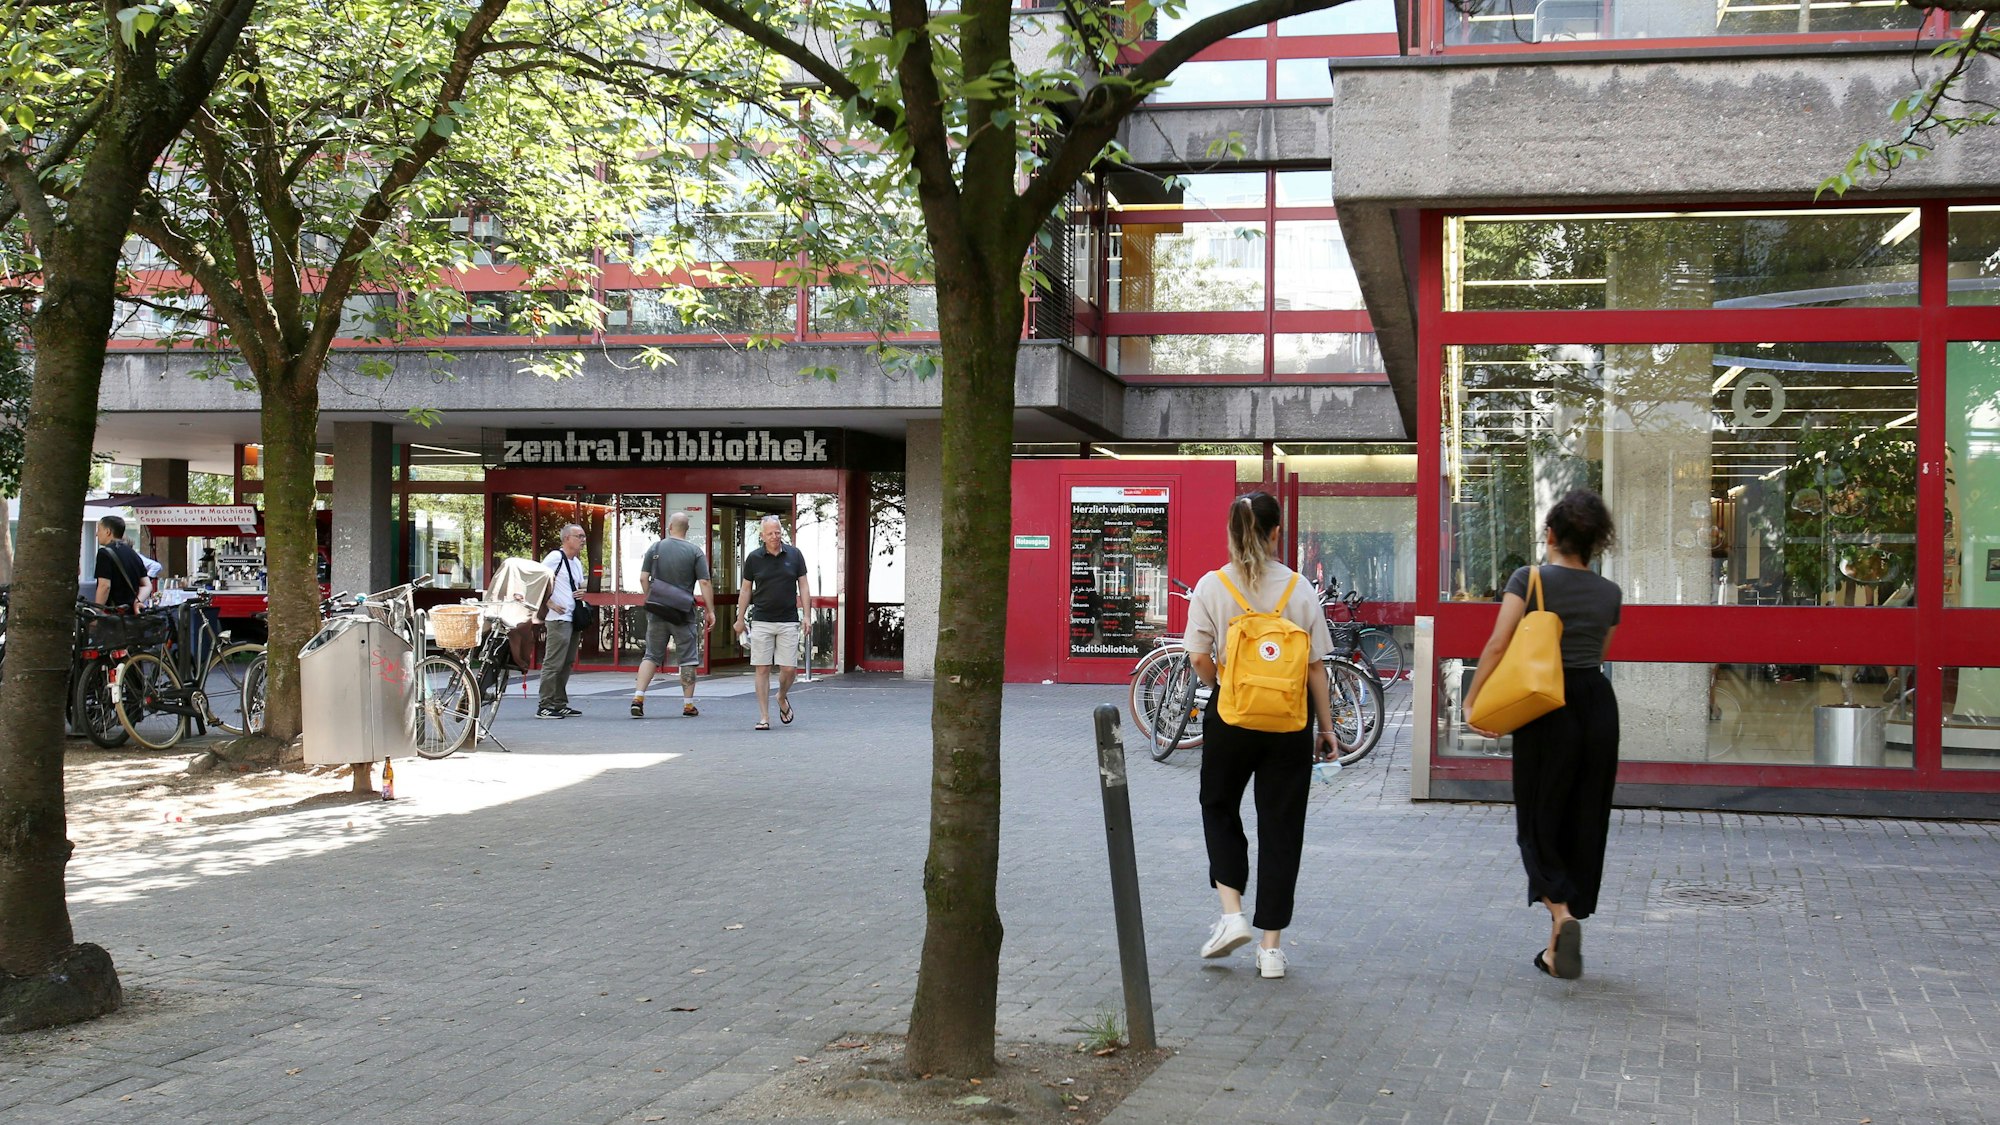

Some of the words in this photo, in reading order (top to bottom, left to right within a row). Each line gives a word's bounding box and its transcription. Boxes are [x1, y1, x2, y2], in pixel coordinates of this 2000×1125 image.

[503, 430, 828, 463] zentral-bibliothek
[135, 508, 172, 516] Espresso
[1072, 505, 1109, 514] Herzlich
[1110, 505, 1165, 514] willkommen
[1016, 538, 1048, 547] Notausgang
[1071, 644, 1139, 654] Stadtbibliothek
